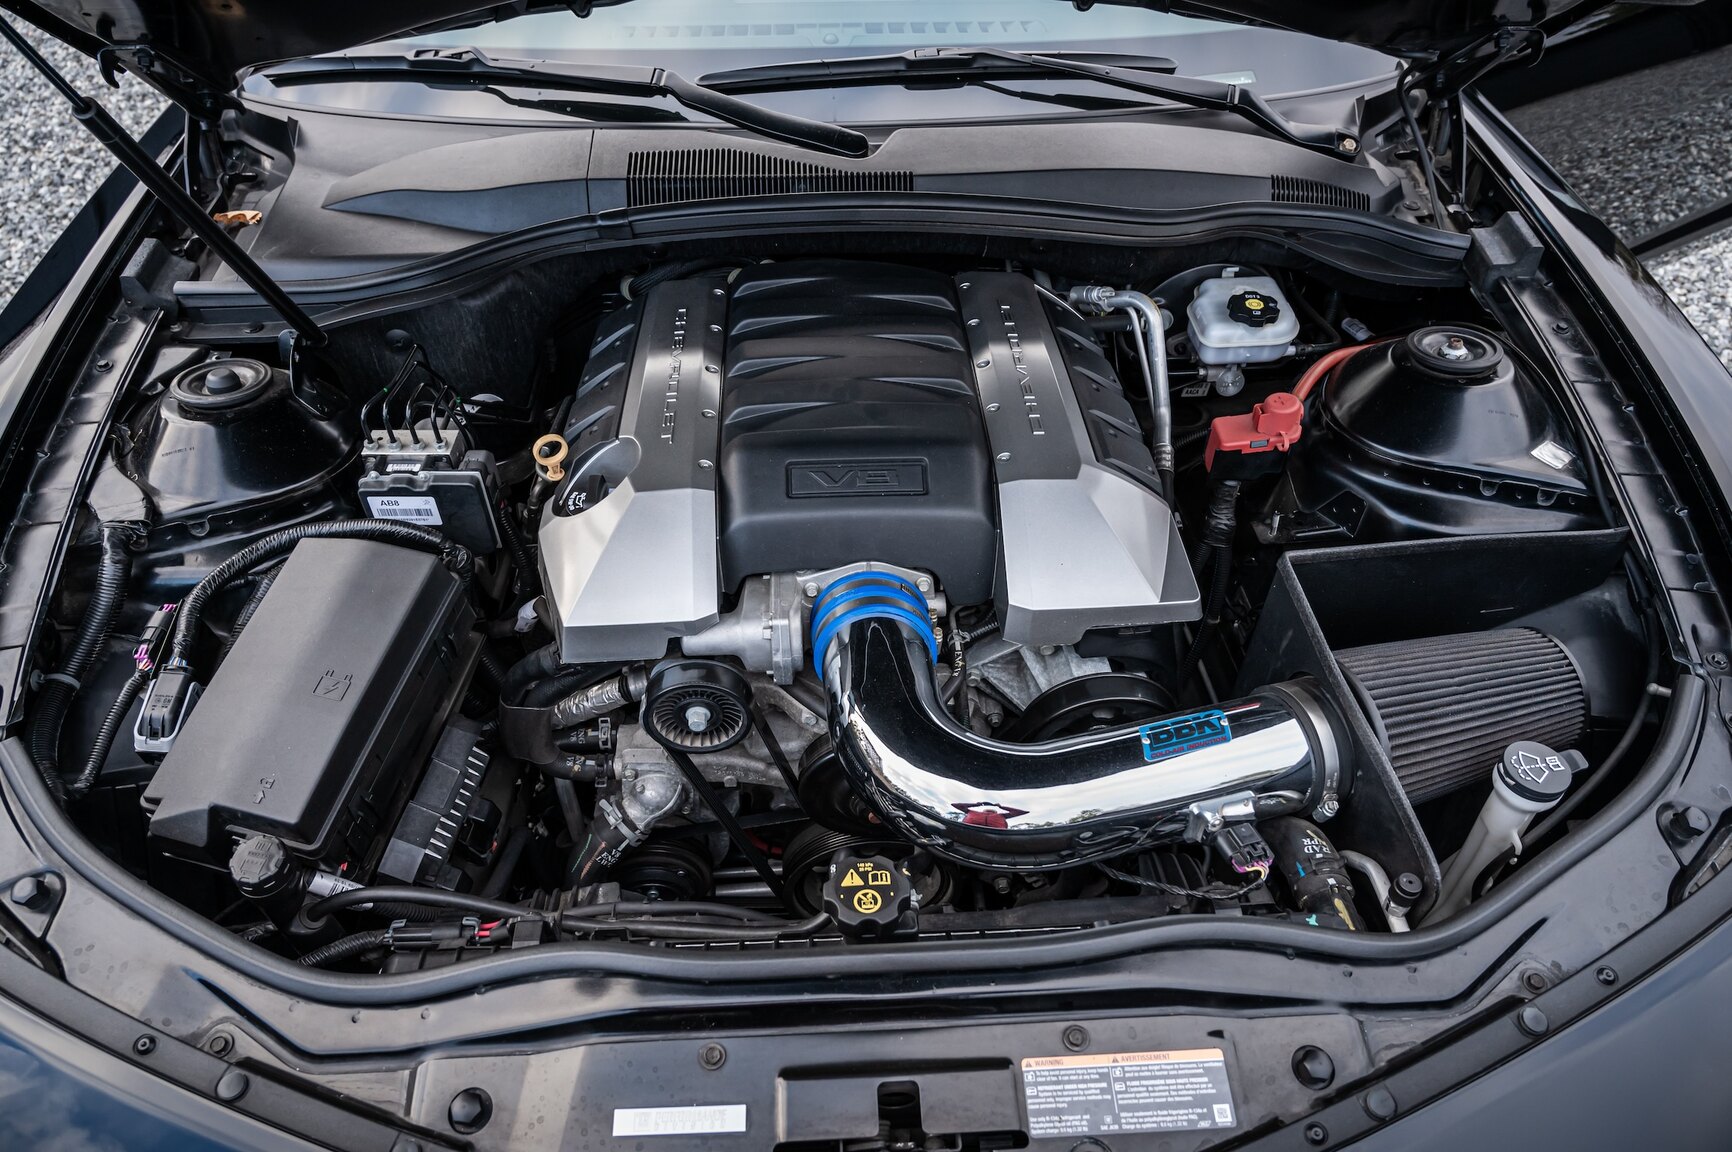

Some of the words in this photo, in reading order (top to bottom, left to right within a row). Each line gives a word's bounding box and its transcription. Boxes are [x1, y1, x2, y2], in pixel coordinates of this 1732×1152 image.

[660, 308, 686, 444] CHEVROLET
[997, 299, 1045, 436] CHEVROLET
[807, 468, 898, 488] V8
[1121, 1053, 1170, 1062] AVERTISSEMENT
